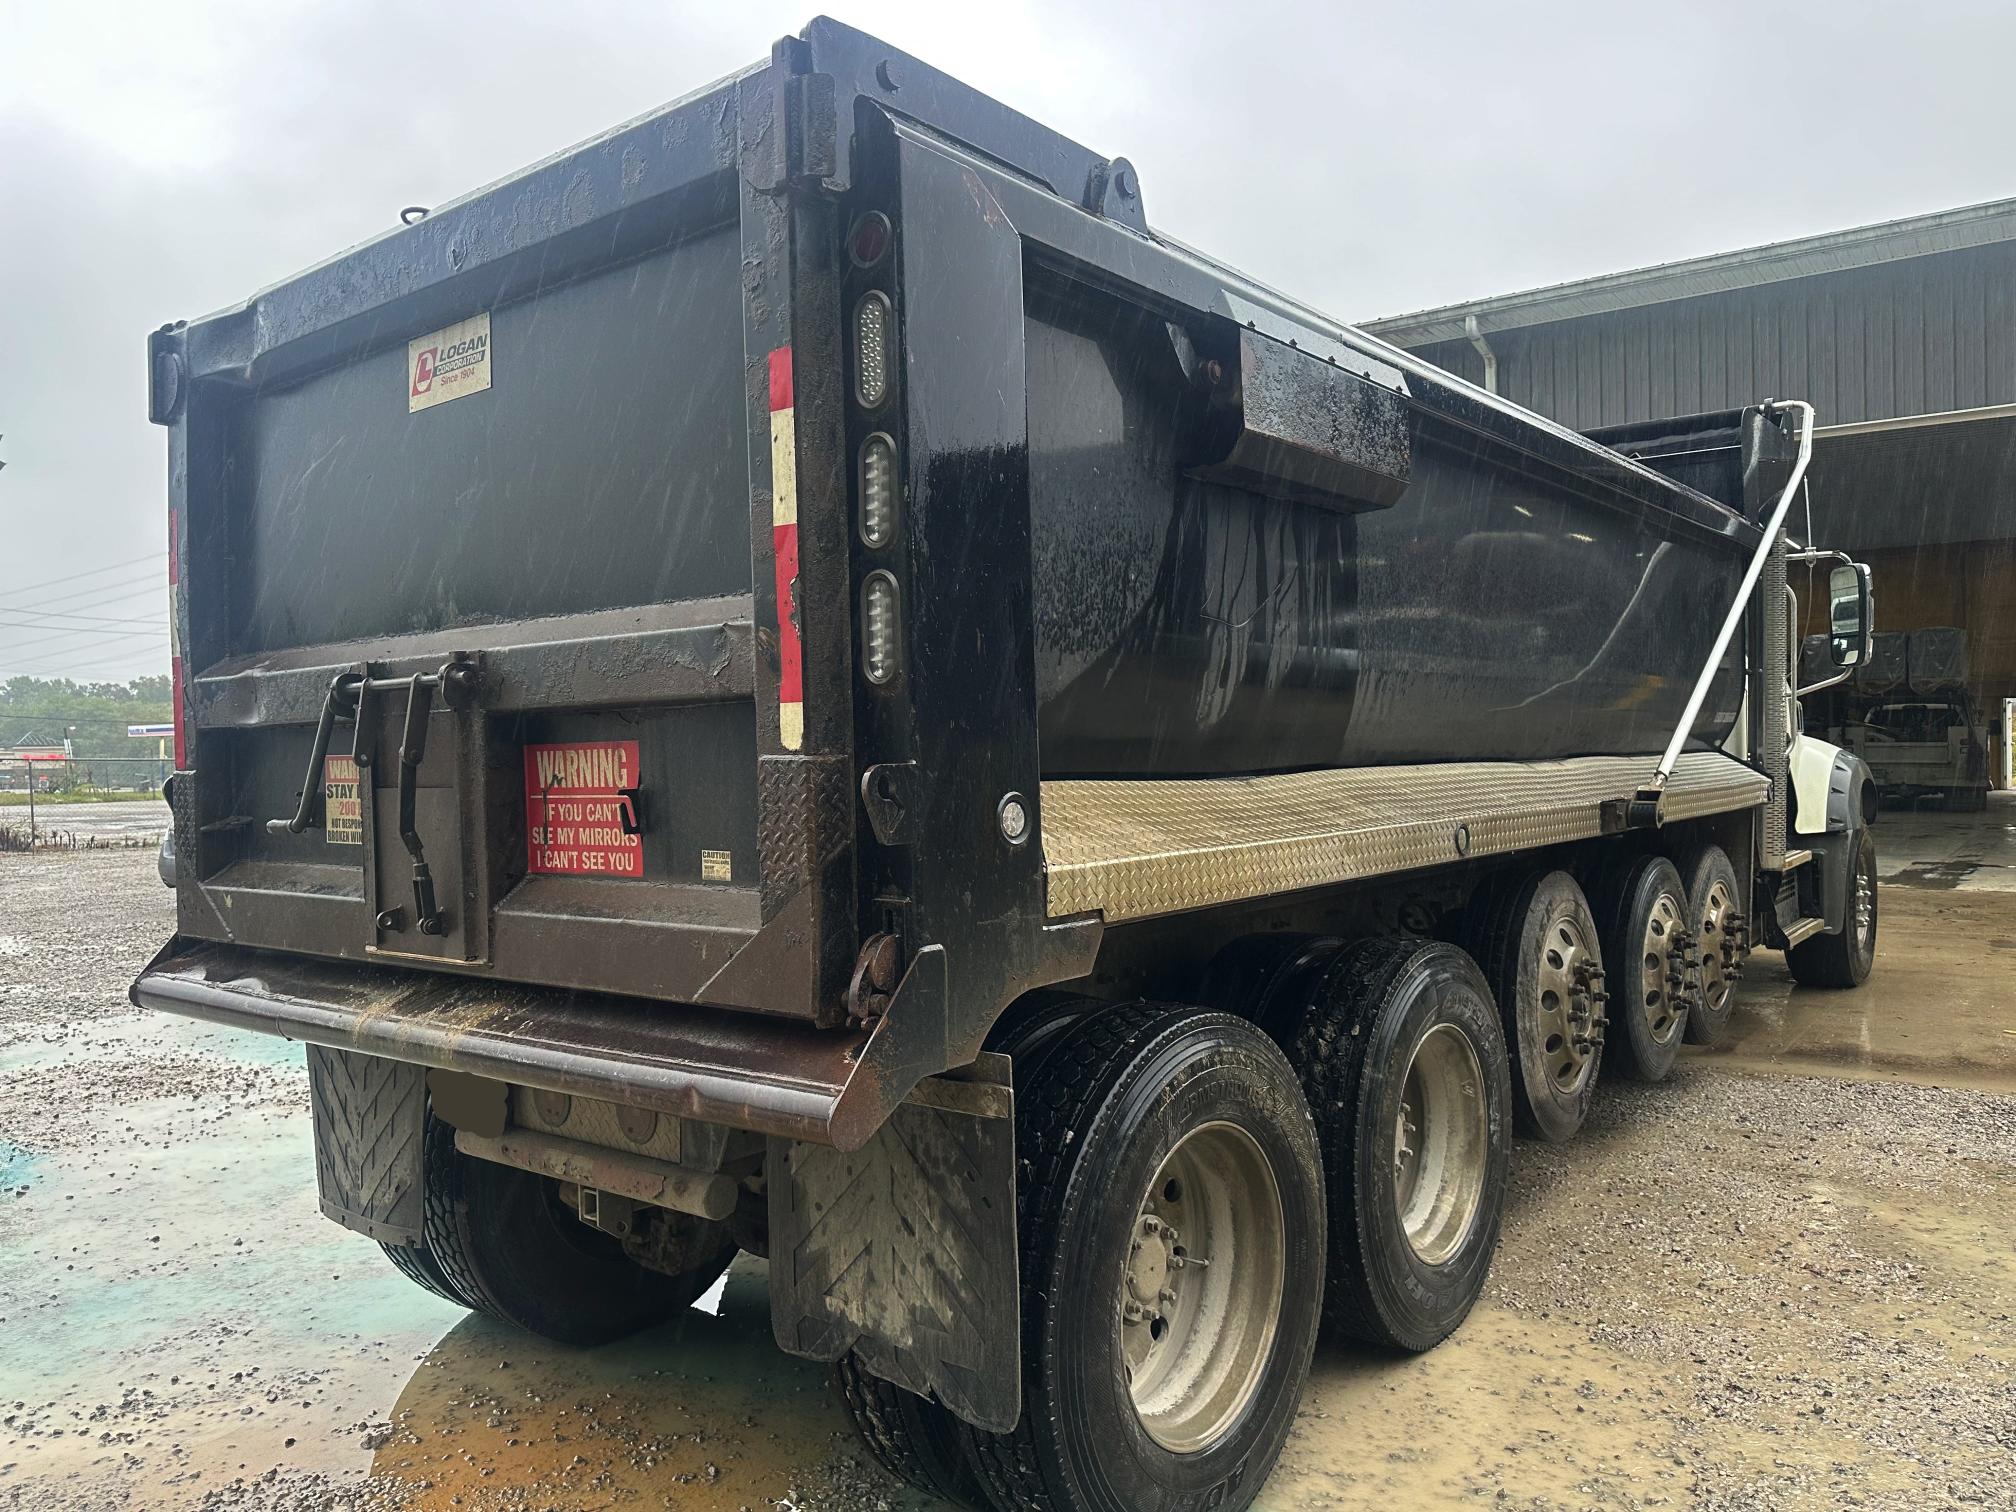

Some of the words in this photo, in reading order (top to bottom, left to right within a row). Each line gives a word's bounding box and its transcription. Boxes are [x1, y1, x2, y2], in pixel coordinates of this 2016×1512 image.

[439, 334, 488, 362] LOGAN
[436, 354, 483, 374] CORPORATION
[441, 372, 458, 386] Since
[460, 367, 475, 380] 1904
[536, 748, 628, 788] WARNING
[327, 784, 354, 799] STAY
[340, 801, 356, 816] 200
[558, 803, 582, 821] YOU
[586, 803, 621, 822] CAN'T
[557, 827, 575, 845] MY
[579, 827, 638, 847] MIRRORS
[537, 850, 541, 867] I
[545, 850, 578, 869] CAN'T
[582, 851, 605, 870] SEE
[608, 852, 634, 871] YOU
[703, 851, 729, 859] CAUTION
